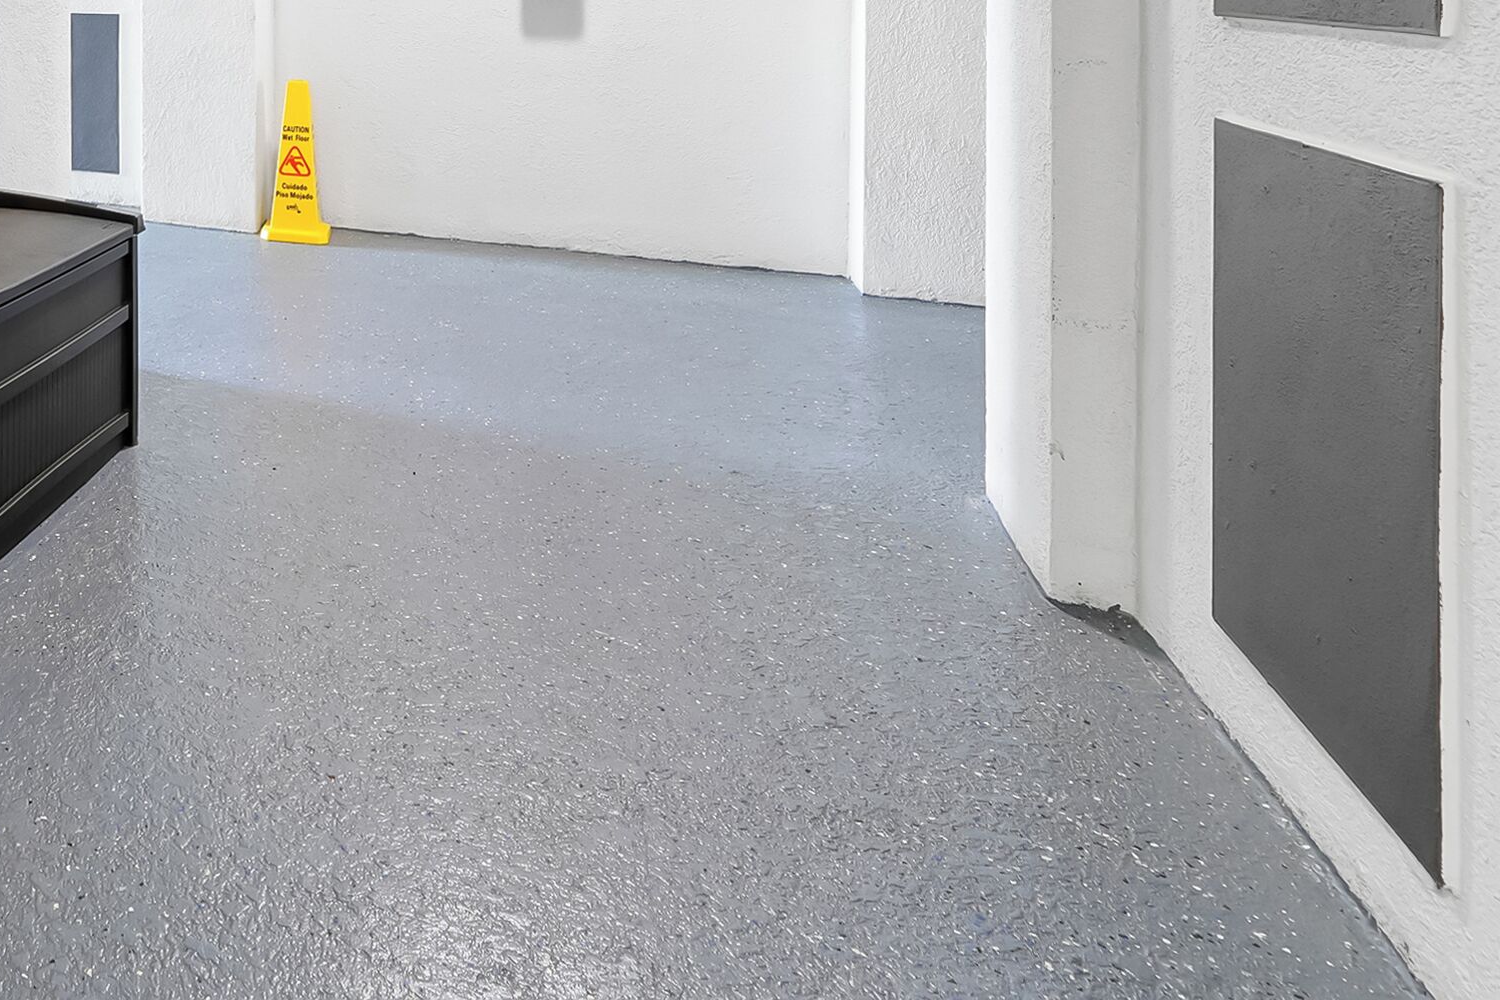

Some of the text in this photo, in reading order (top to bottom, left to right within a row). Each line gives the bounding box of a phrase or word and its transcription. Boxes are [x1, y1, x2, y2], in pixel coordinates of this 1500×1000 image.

[282, 125, 310, 133] CAUTION
[296, 134, 310, 142] Floor
[281, 183, 308, 191] Cuidado
[276, 190, 314, 201] Piso Mojado
